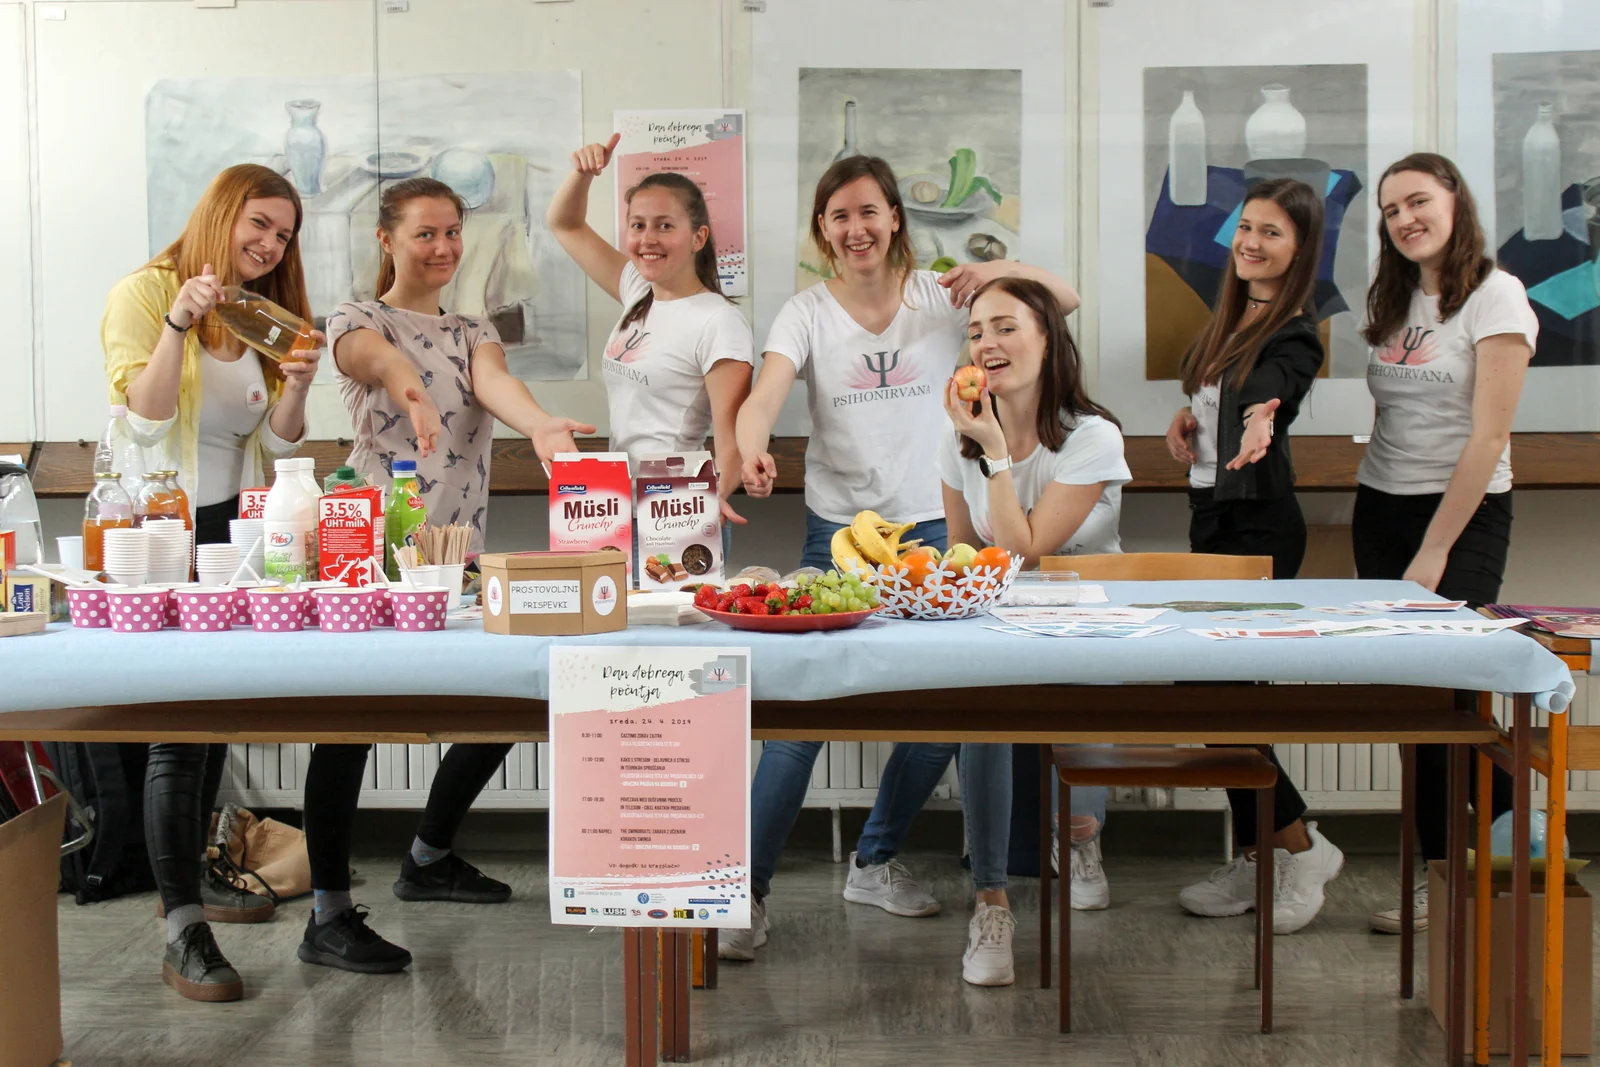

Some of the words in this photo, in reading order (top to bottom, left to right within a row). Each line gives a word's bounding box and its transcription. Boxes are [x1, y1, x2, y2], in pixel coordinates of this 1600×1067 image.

[648, 123, 666, 132] Dan
[668, 122, 703, 136] dobrega
[653, 135, 688, 147] počutja
[1368, 364, 1454, 383] SIHONIRVANA
[833, 384, 931, 407] PSIHONIRVANA
[247, 495, 267, 509] 3,5
[325, 502, 362, 518] 3,5%
[564, 498, 618, 519] Müsli
[651, 496, 704, 518] Müsli
[326, 519, 344, 528] UHT
[346, 518, 365, 528] milk
[568, 517, 613, 532] Crunchy
[655, 515, 699, 531] Crunchy
[523, 601, 568, 609] PRISPEVKI
[603, 666, 629, 681] Dan
[632, 664, 686, 686] dobrega
[610, 684, 661, 703] počutja
